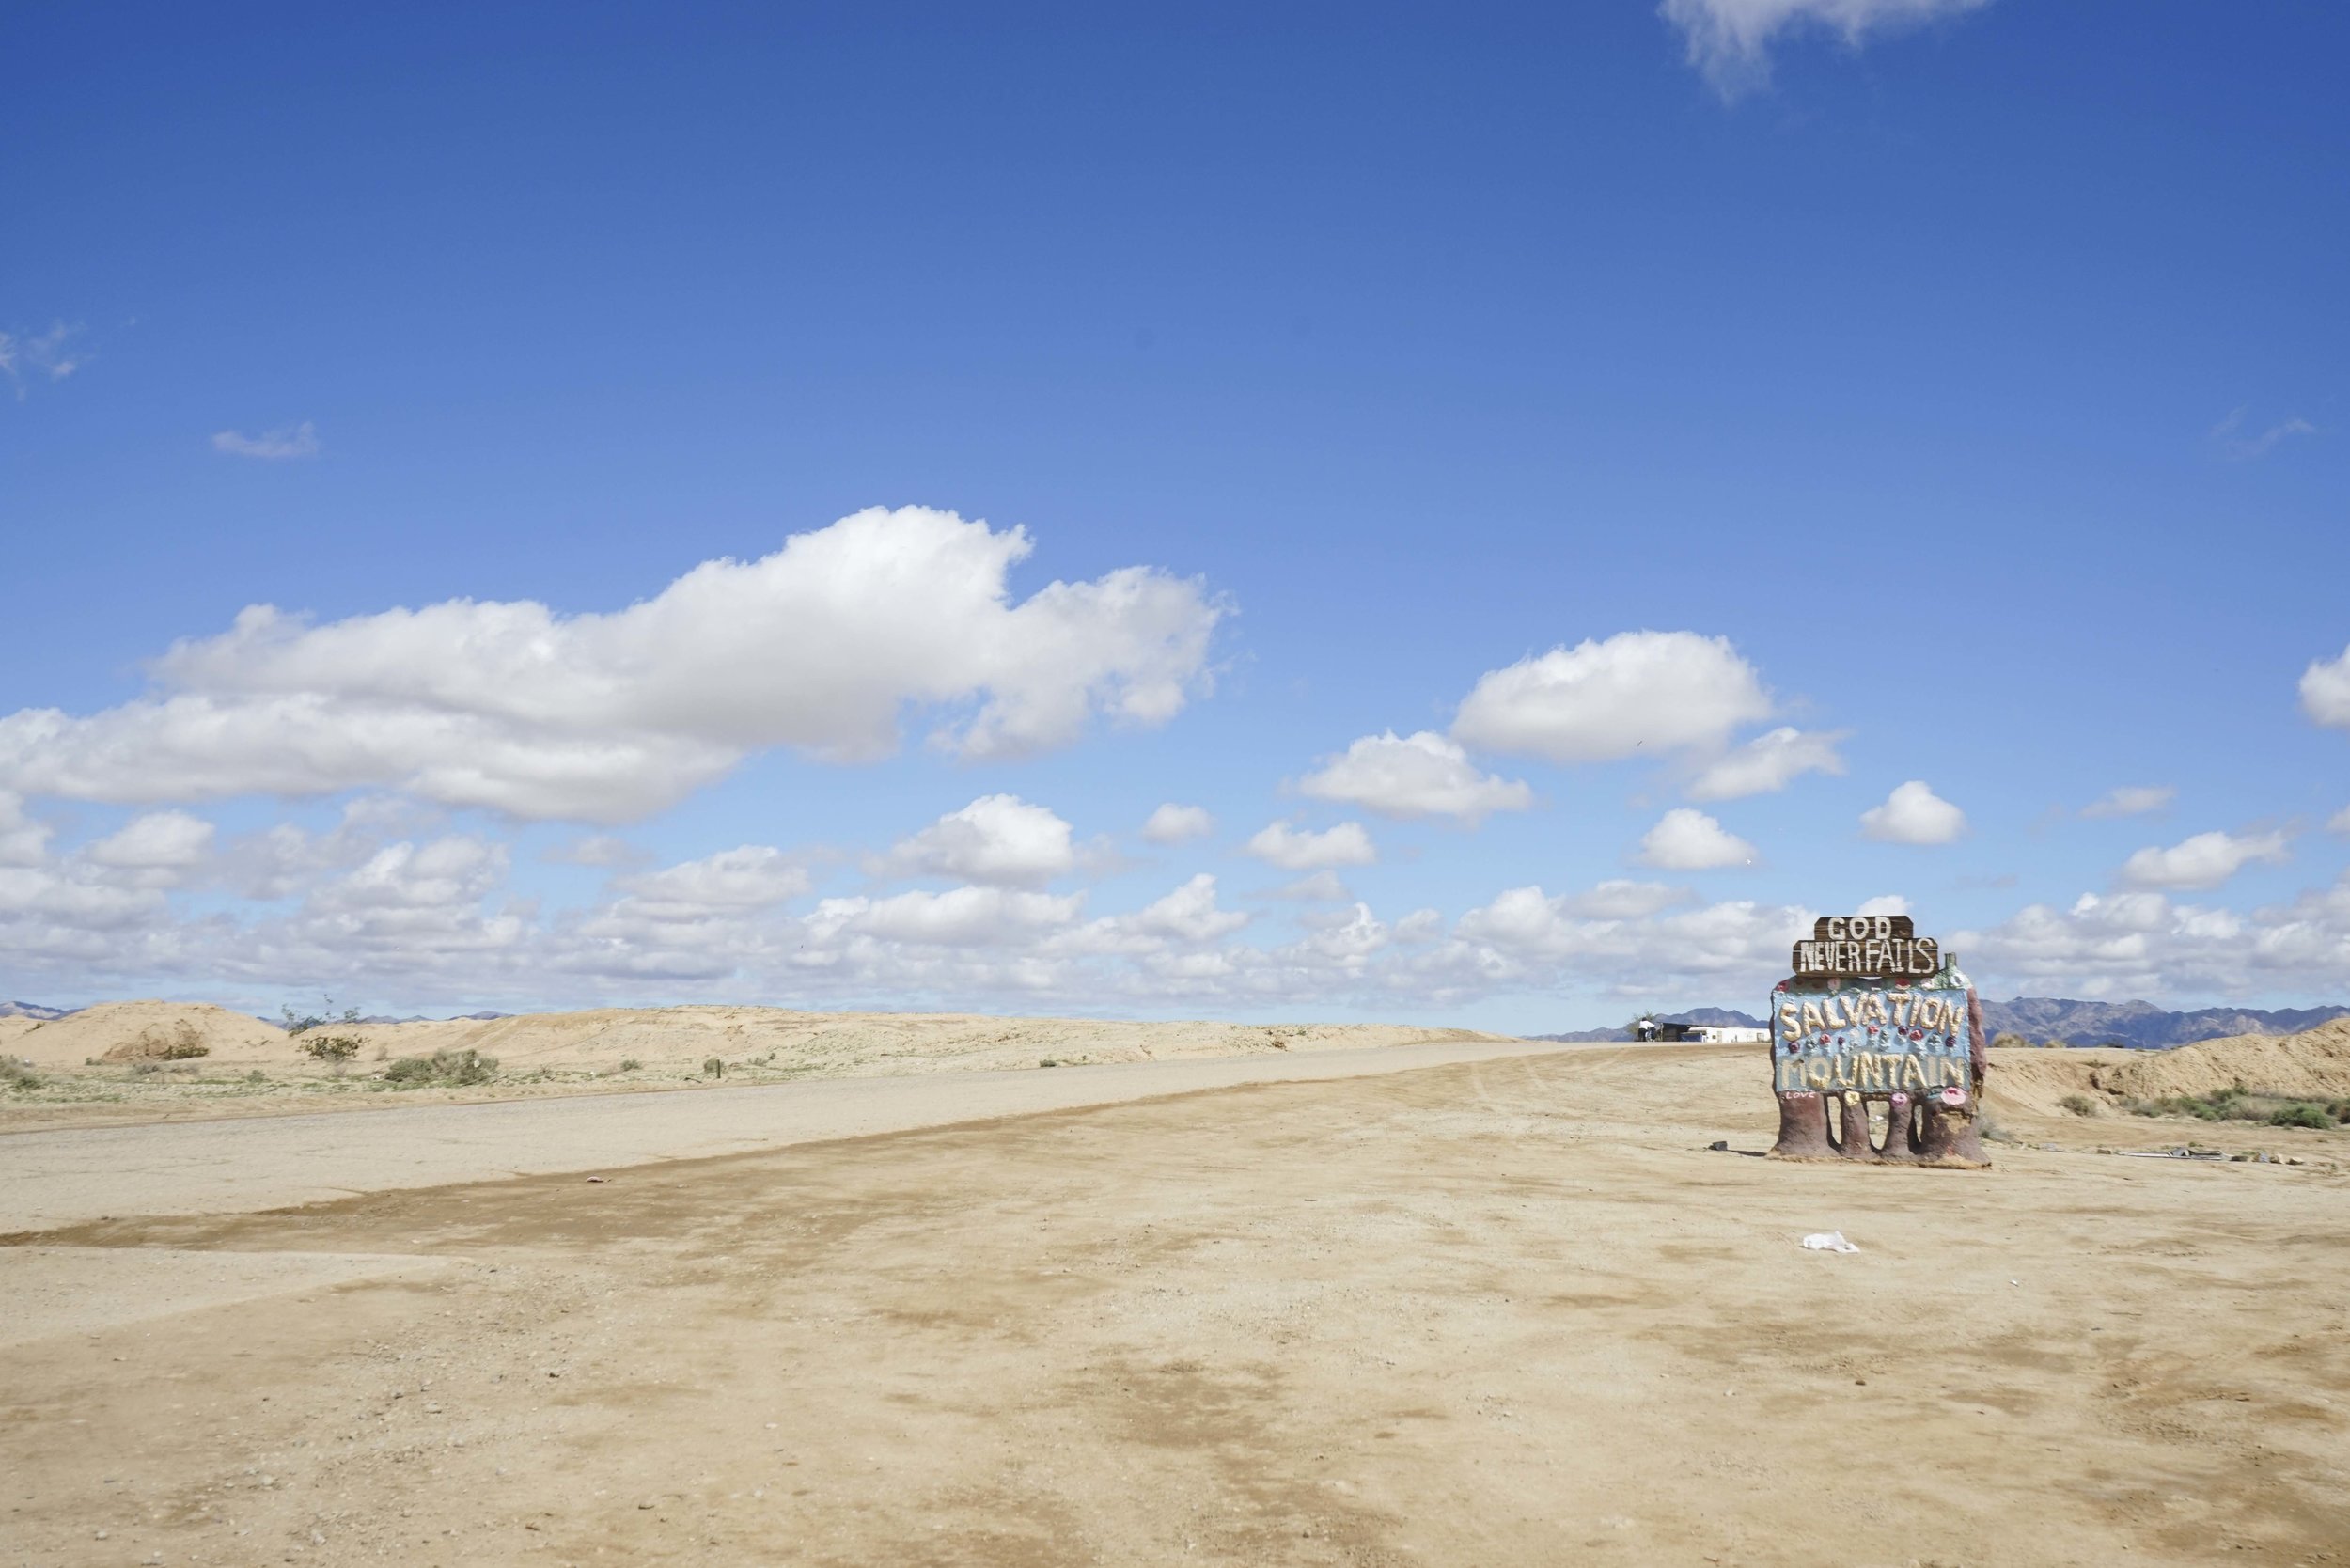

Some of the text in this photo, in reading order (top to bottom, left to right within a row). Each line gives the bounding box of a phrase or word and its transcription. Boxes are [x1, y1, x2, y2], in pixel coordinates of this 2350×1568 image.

[1828, 917, 1891, 939] GOD
[1800, 937, 1935, 974] NEVER FAILS
[1778, 993, 1964, 1042] SALVATION
[1781, 1051, 1964, 1090] MOUNTAIN
[1786, 1091, 1816, 1100] LOVE
